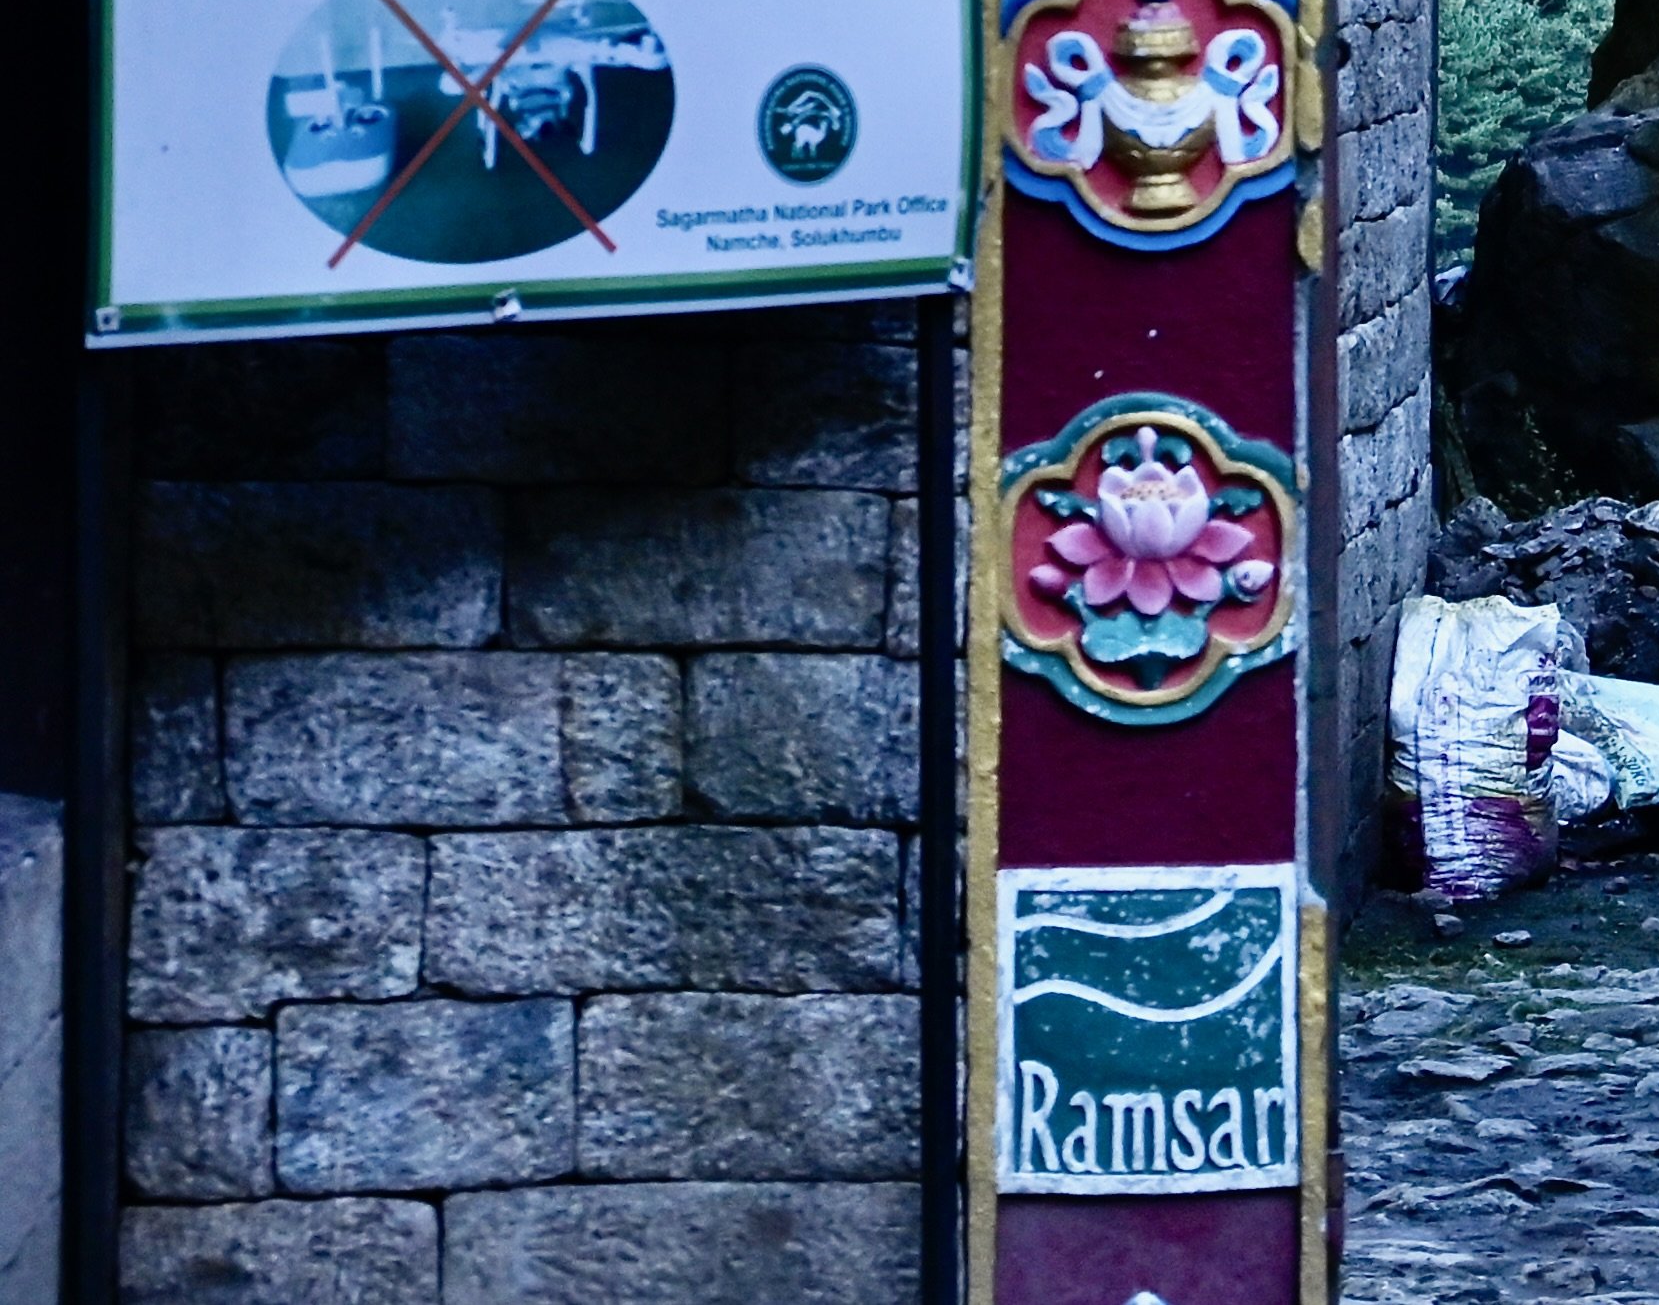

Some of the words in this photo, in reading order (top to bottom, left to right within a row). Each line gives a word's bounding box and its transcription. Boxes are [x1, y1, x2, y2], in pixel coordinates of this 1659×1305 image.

[655, 206, 768, 231] Sagarmatha
[773, 200, 847, 221] National
[853, 198, 890, 217] Park
[897, 195, 948, 215] Office
[791, 226, 902, 248] Solukhumbu
[1018, 1060, 1284, 1173] Ramsar
